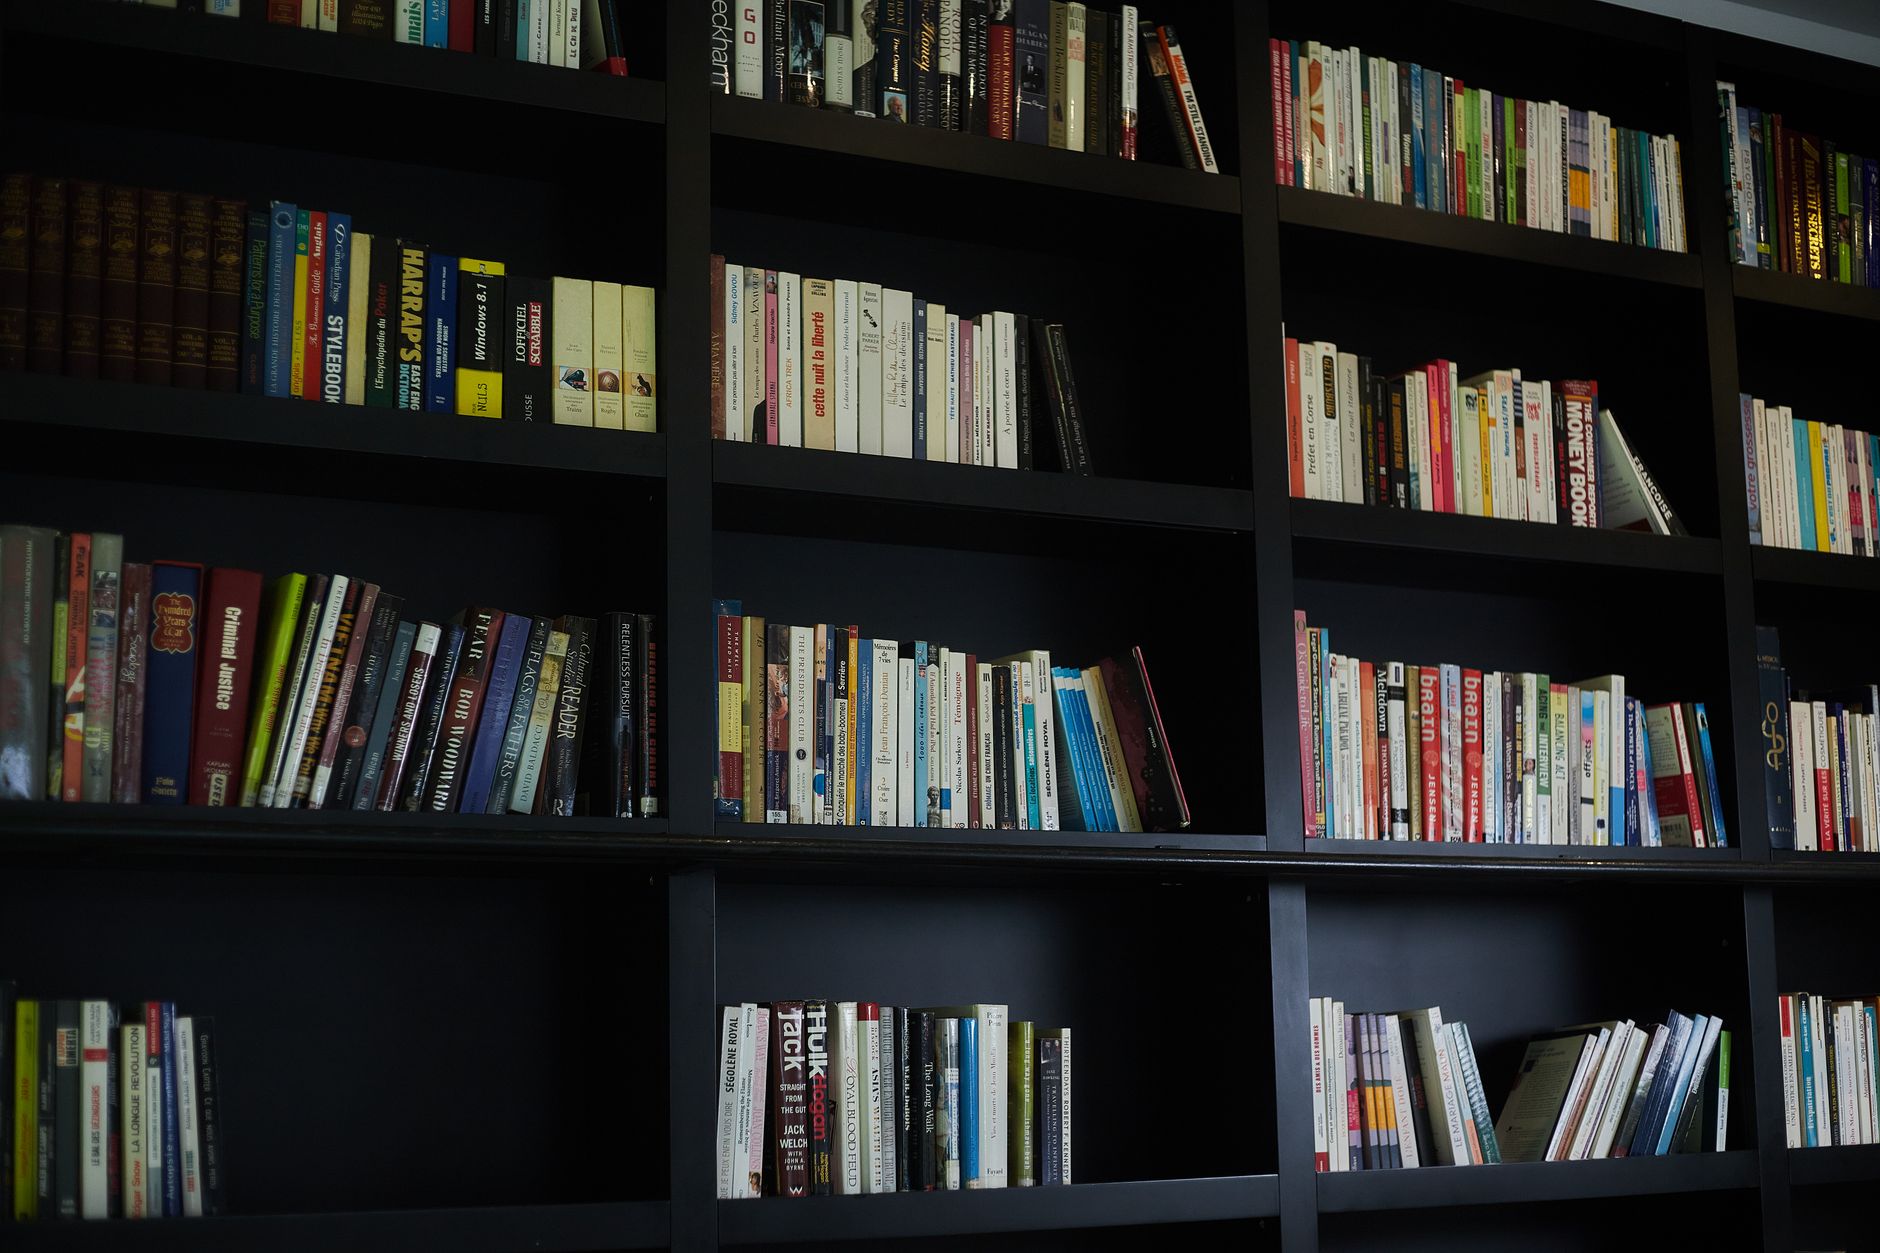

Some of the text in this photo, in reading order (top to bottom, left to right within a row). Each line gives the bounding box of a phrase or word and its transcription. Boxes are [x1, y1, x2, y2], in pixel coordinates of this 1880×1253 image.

[571, 25, 577, 34] DE
[912, 22, 938, 72] Money
[968, 35, 977, 56] THE
[1127, 8, 1136, 81] LANCE ARMSTRONG
[978, 29, 987, 100] THE SHADOW
[1272, 50, 1280, 66] VOUS
[992, 53, 1001, 124] LIVING HISTORY
[1186, 104, 1212, 167] STILL STANDING
[1743, 149, 1754, 233] PSYCHOLOGY
[1804, 158, 1822, 269] HEALTH SECRETS
[313, 222, 324, 262] Anglais
[311, 270, 322, 294] Guide
[400, 249, 424, 363] HARRAP'S
[730, 274, 740, 325] Sidney GOVOU
[749, 273, 760, 316] AZNAVOUR
[248, 301, 265, 341] Purpose
[324, 242, 346, 404] Canadian STYLEBOOK
[474, 283, 488, 361] Windows 8.1
[530, 304, 542, 365] SCRABBLE
[897, 322, 907, 357] décisions
[411, 364, 422, 390] EASY
[784, 358, 792, 408] AFRICA TREK
[811, 311, 826, 418] cette nuit la liberté
[1305, 394, 1317, 475] Préfet en Corse
[1583, 402, 1595, 482] THE CONSUMER
[1742, 400, 1758, 512] votre grossesse
[1566, 400, 1588, 528] MONEY BOOK
[326, 585, 344, 630] FREEDMAN
[120, 633, 143, 684] Sociology
[215, 605, 242, 711] Criminal Justice
[471, 613, 492, 661] FEAR
[520, 650, 541, 694] FLAGS
[575, 643, 591, 688] Cultural
[620, 622, 631, 720] RELENTLESS PURSUIT
[837, 660, 847, 691] Serrière
[392, 667, 425, 762] WINNERS AND LOSERS
[556, 648, 582, 740] Studies READER
[952, 672, 963, 726] Témoignage
[1312, 687, 1321, 716] Starting
[1376, 669, 1388, 733] Meltdown
[499, 714, 526, 780] FATHERS
[836, 702, 848, 745] baby-boomers
[1538, 688, 1549, 788] ACING INTERVIEW
[1554, 712, 1566, 761] BALANCING
[431, 688, 474, 812] BOB WOODWARD
[520, 725, 543, 801] DAVID BALDACCI
[955, 735, 963, 766] Sarkozy
[1042, 749, 1053, 798] SÉGOLÈNE
[1428, 773, 1437, 823] JENSEN
[1471, 774, 1479, 824] JENSEN
[1816, 710, 1831, 841] LA VÉRITÉ SUR LES COSMÉTIQUES
[727, 1017, 739, 1045] ROYAL
[777, 1011, 806, 1072] Jack
[1062, 1035, 1070, 1075] THIRTEEN
[1312, 1025, 1320, 1049] HOMMES
[1313, 1050, 1321, 1061] DES
[724, 1047, 737, 1093] SÉGOLÈNE
[779, 1083, 807, 1092] STRAIGHT
[807, 1011, 828, 1141] Hulk Hogan
[871, 1067, 880, 1103] ASIA'S
[129, 1027, 141, 1187] Snow LA LONGUE REVOLUTION
[780, 1106, 807, 1114] THE GUT
[785, 1094, 803, 1103] FROM
[884, 1090, 894, 1122] ENOUGH
[922, 1061, 935, 1134] The Long Walk
[1438, 1048, 1464, 1148] LE MARIAGE MALIN
[779, 1138, 808, 1149] WELCH
[783, 1125, 805, 1135] JACK
[846, 1109, 857, 1187] BLOOD FEUD
[165, 1143, 176, 1200] Autopsie
